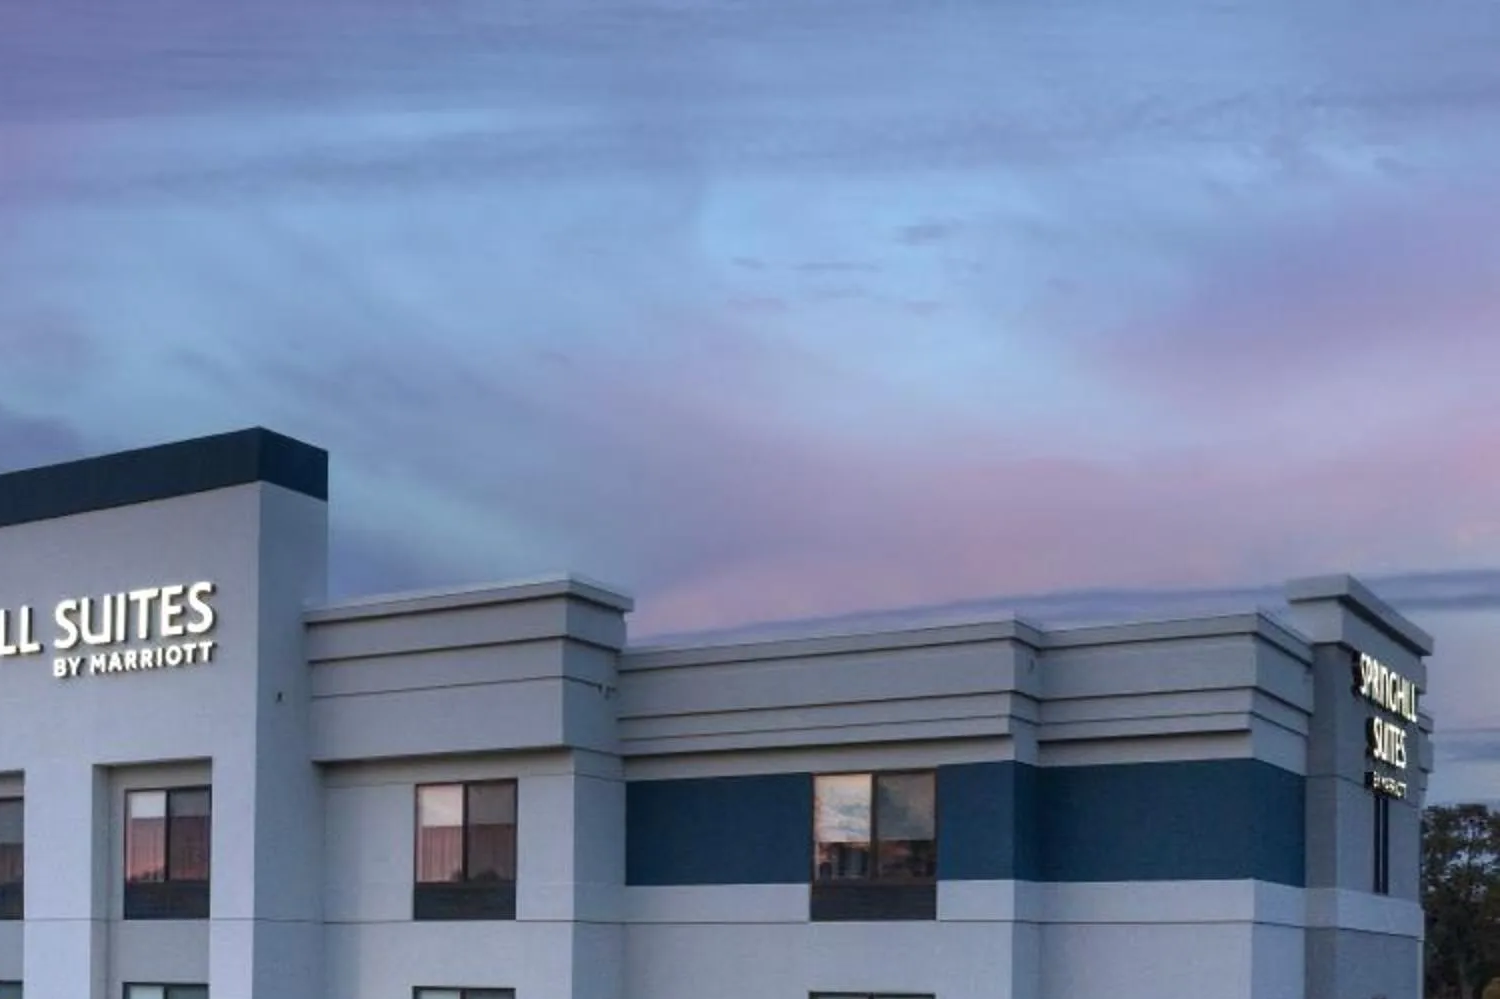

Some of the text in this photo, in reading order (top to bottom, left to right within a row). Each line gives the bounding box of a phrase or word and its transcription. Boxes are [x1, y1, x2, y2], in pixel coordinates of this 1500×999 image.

[54, 581, 216, 650] SUITES
[54, 641, 216, 677] BY MARRIOTT
